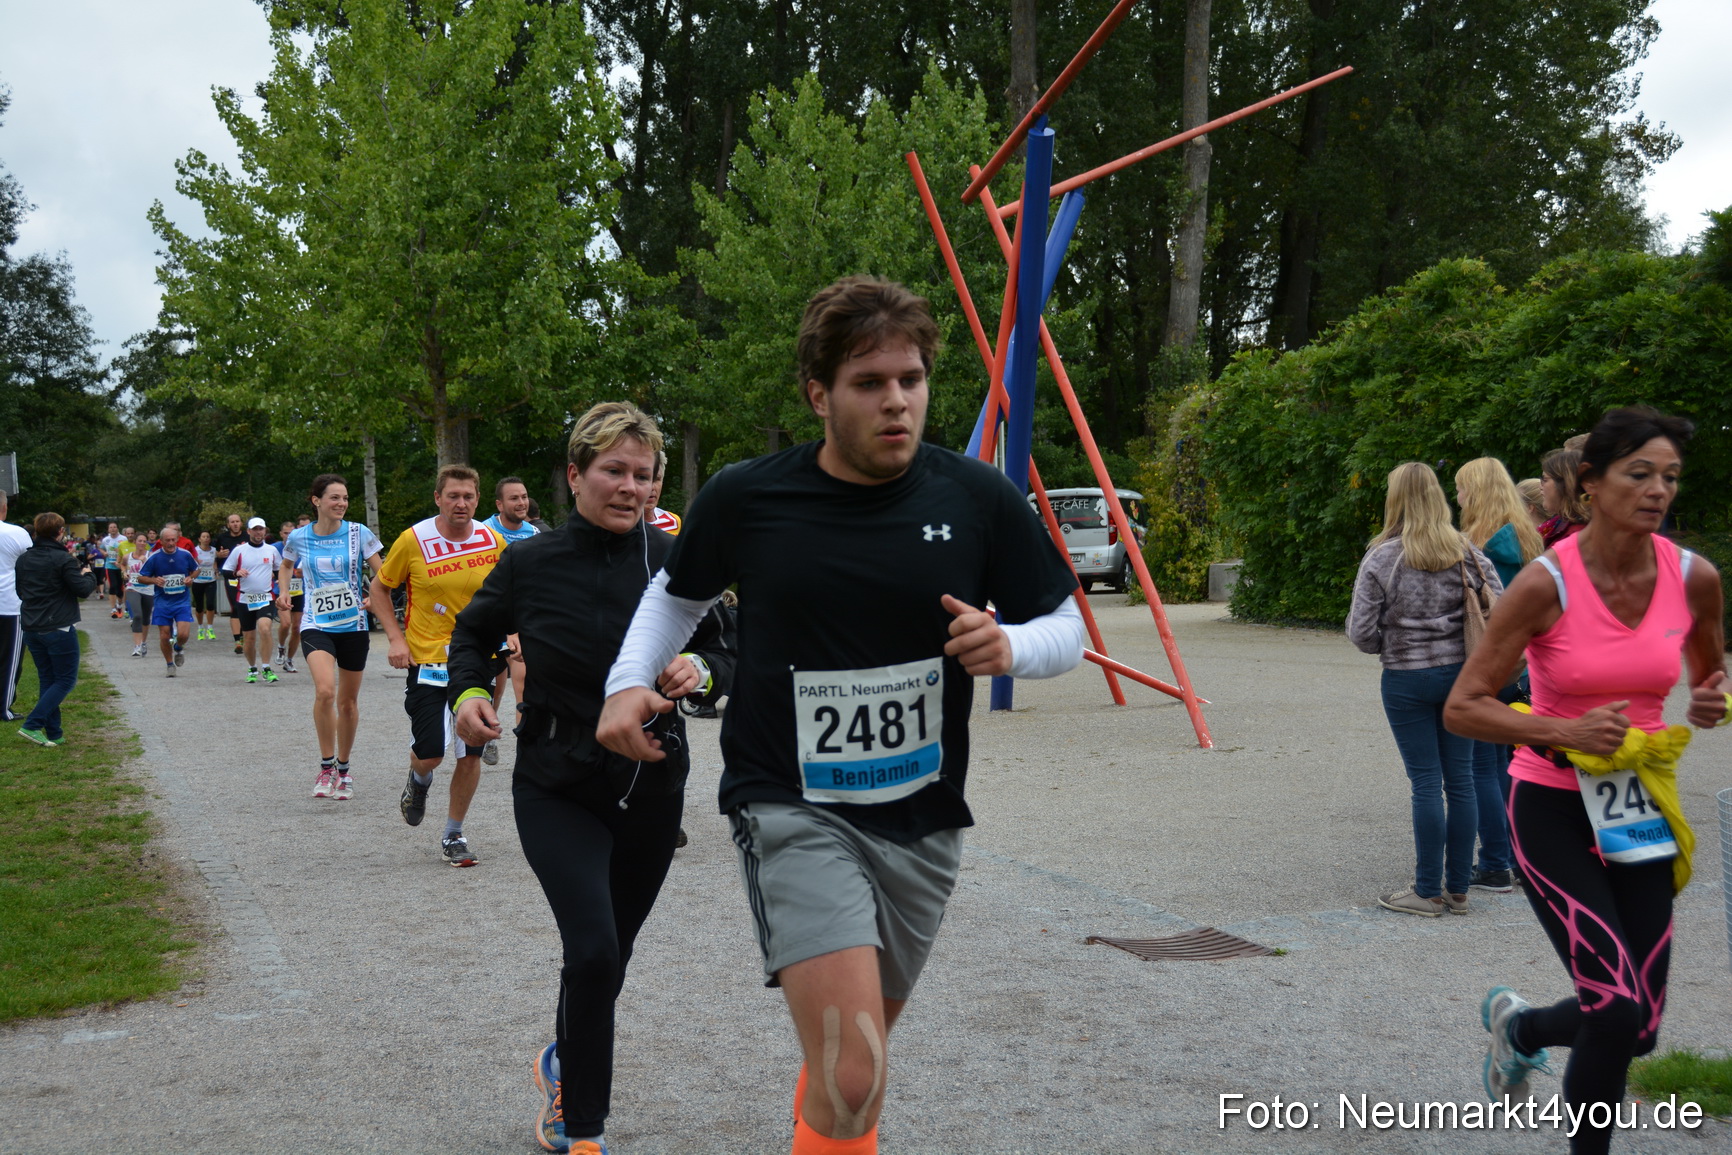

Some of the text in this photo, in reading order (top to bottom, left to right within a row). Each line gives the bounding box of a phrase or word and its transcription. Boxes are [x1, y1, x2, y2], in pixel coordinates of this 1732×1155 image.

[427, 554, 499, 578] MAX BÖGL
[165, 576, 184, 587] 2248
[315, 592, 353, 613] 2575
[327, 612, 347, 621] Katrin
[432, 672, 449, 680] Rich
[799, 677, 921, 698] PARTL Neumarkt
[814, 693, 927, 754] 2481
[832, 759, 919, 788] Benjamin
